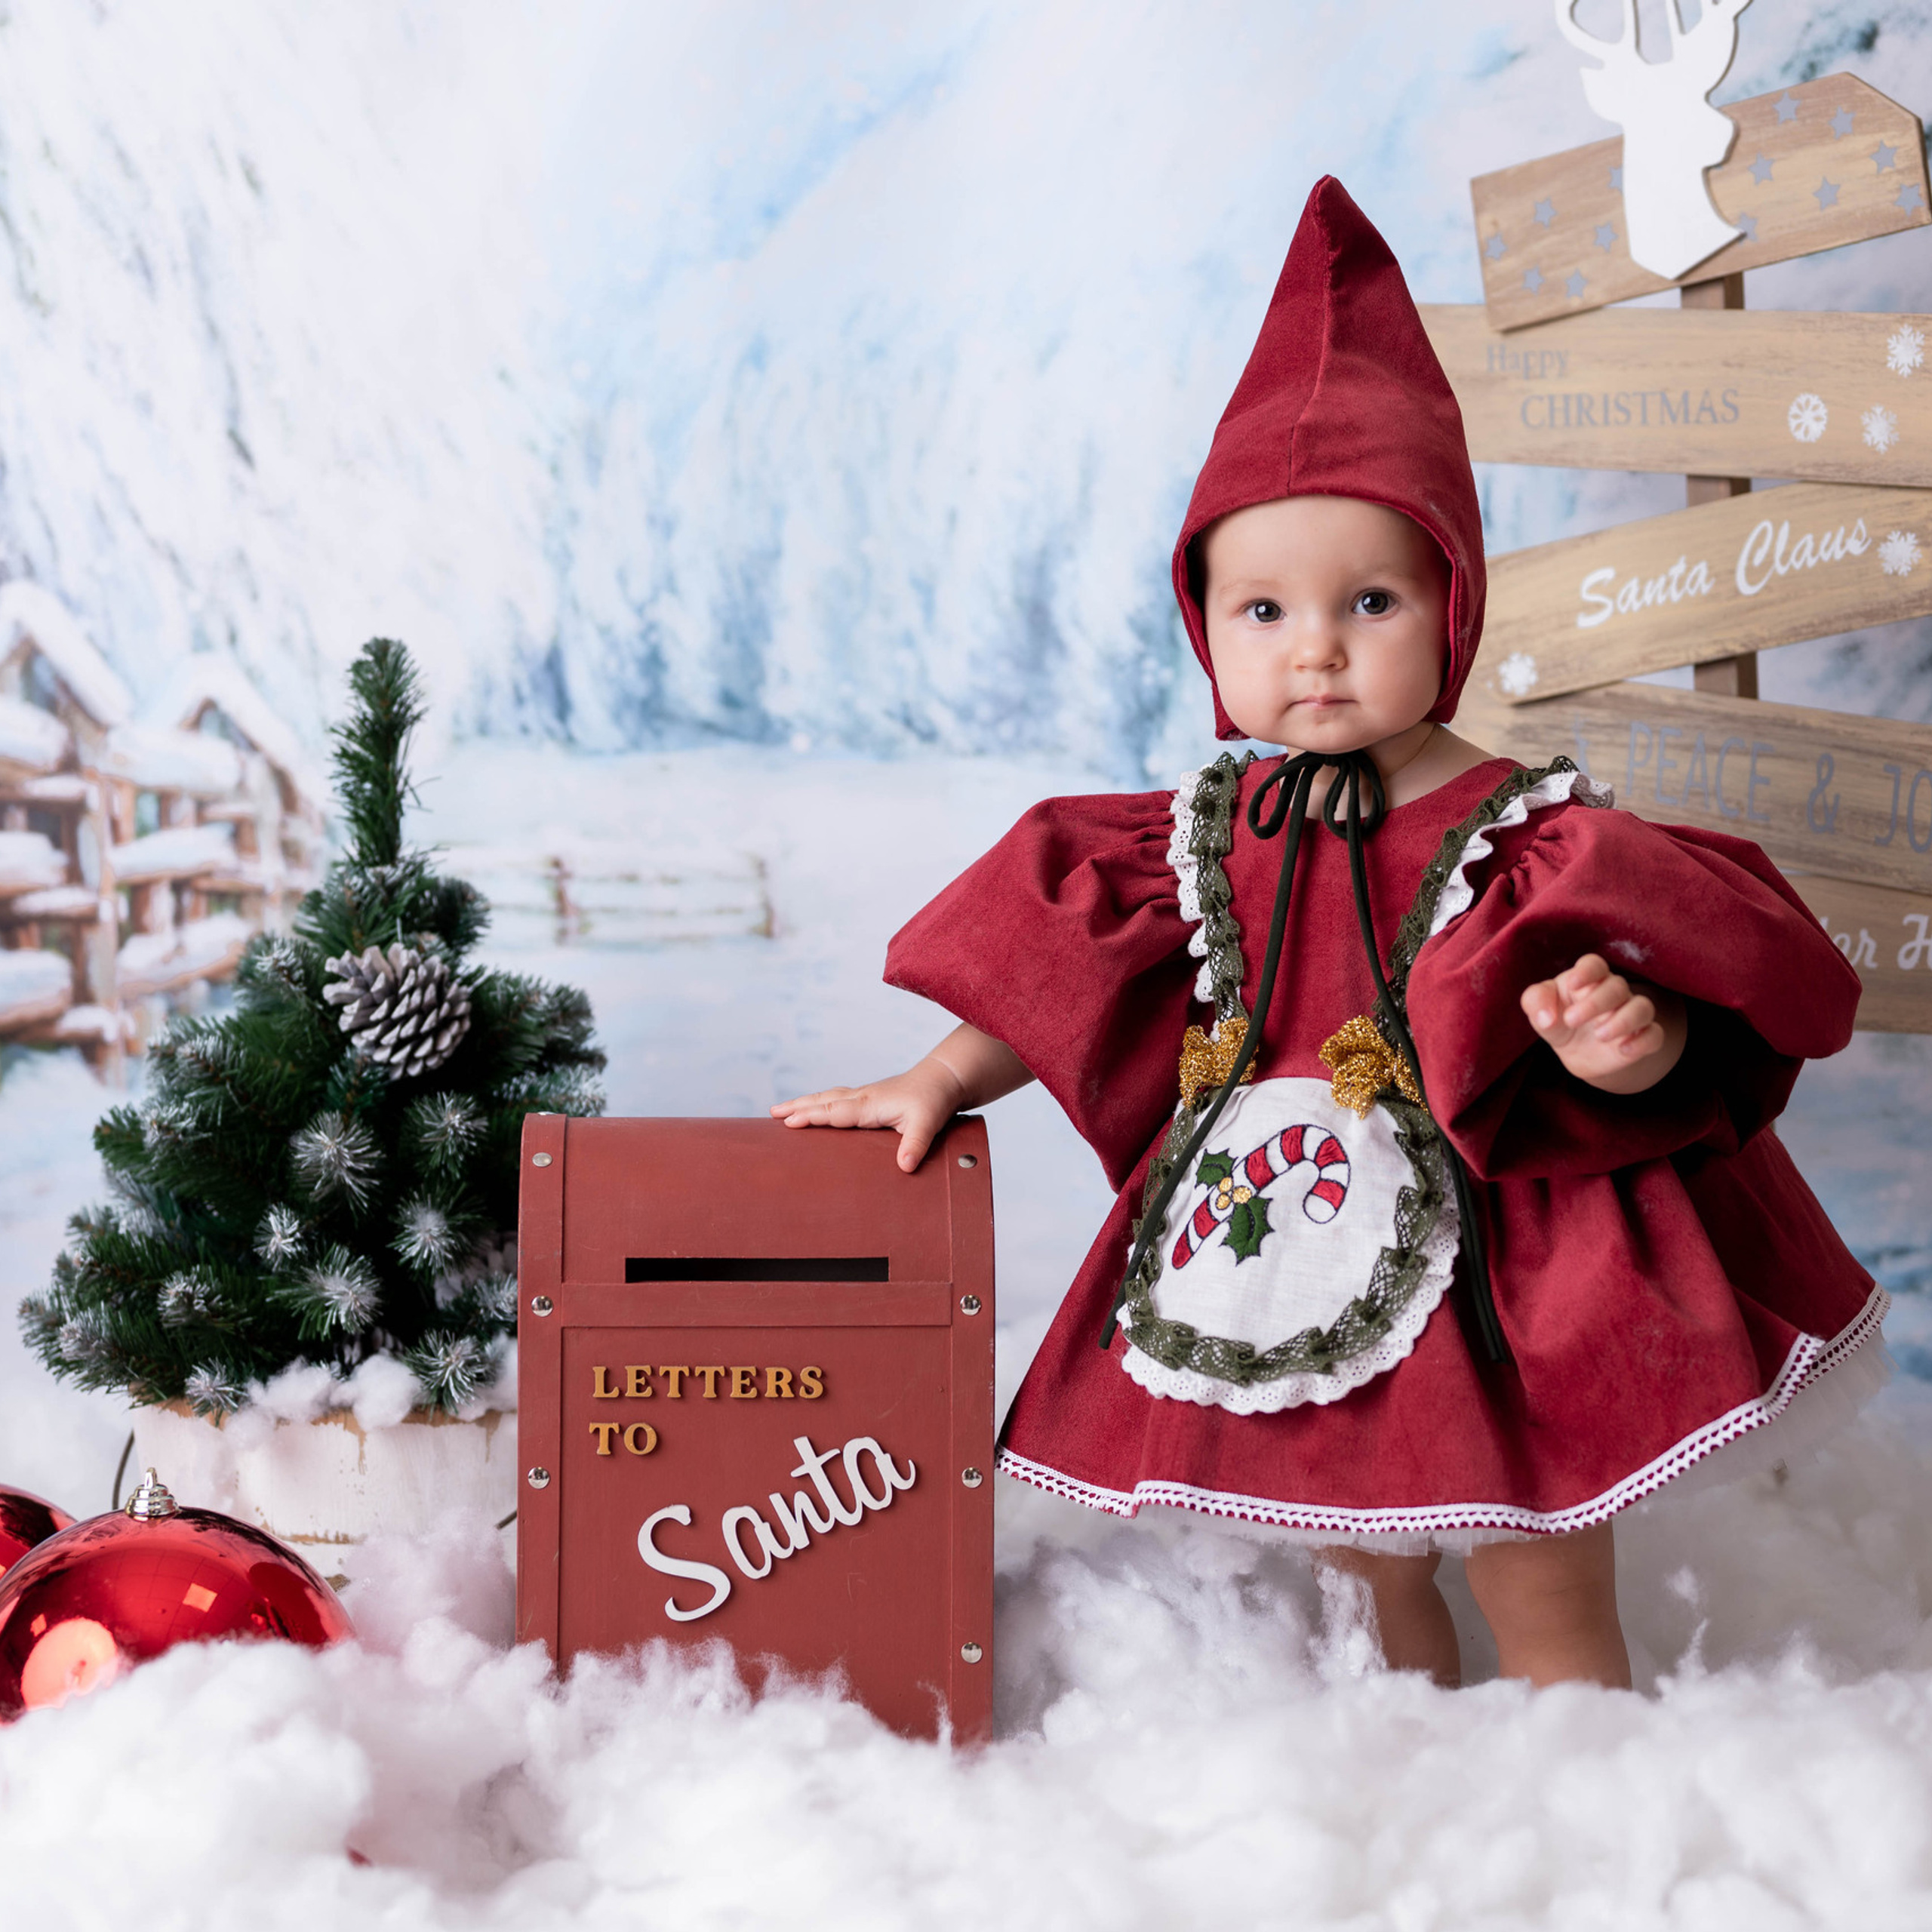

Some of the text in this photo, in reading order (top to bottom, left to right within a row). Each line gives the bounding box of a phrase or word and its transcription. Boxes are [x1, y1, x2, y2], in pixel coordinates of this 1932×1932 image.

[1521, 389, 1740, 430] CHRISTMAS
[1577, 518, 1872, 628] Santa Claus
[1625, 721, 1775, 823] PEACE
[1806, 753, 1841, 835] &
[592, 1365, 826, 1400] LETTERS
[589, 1422, 658, 1456] TO
[637, 1435, 917, 1623] Santa
